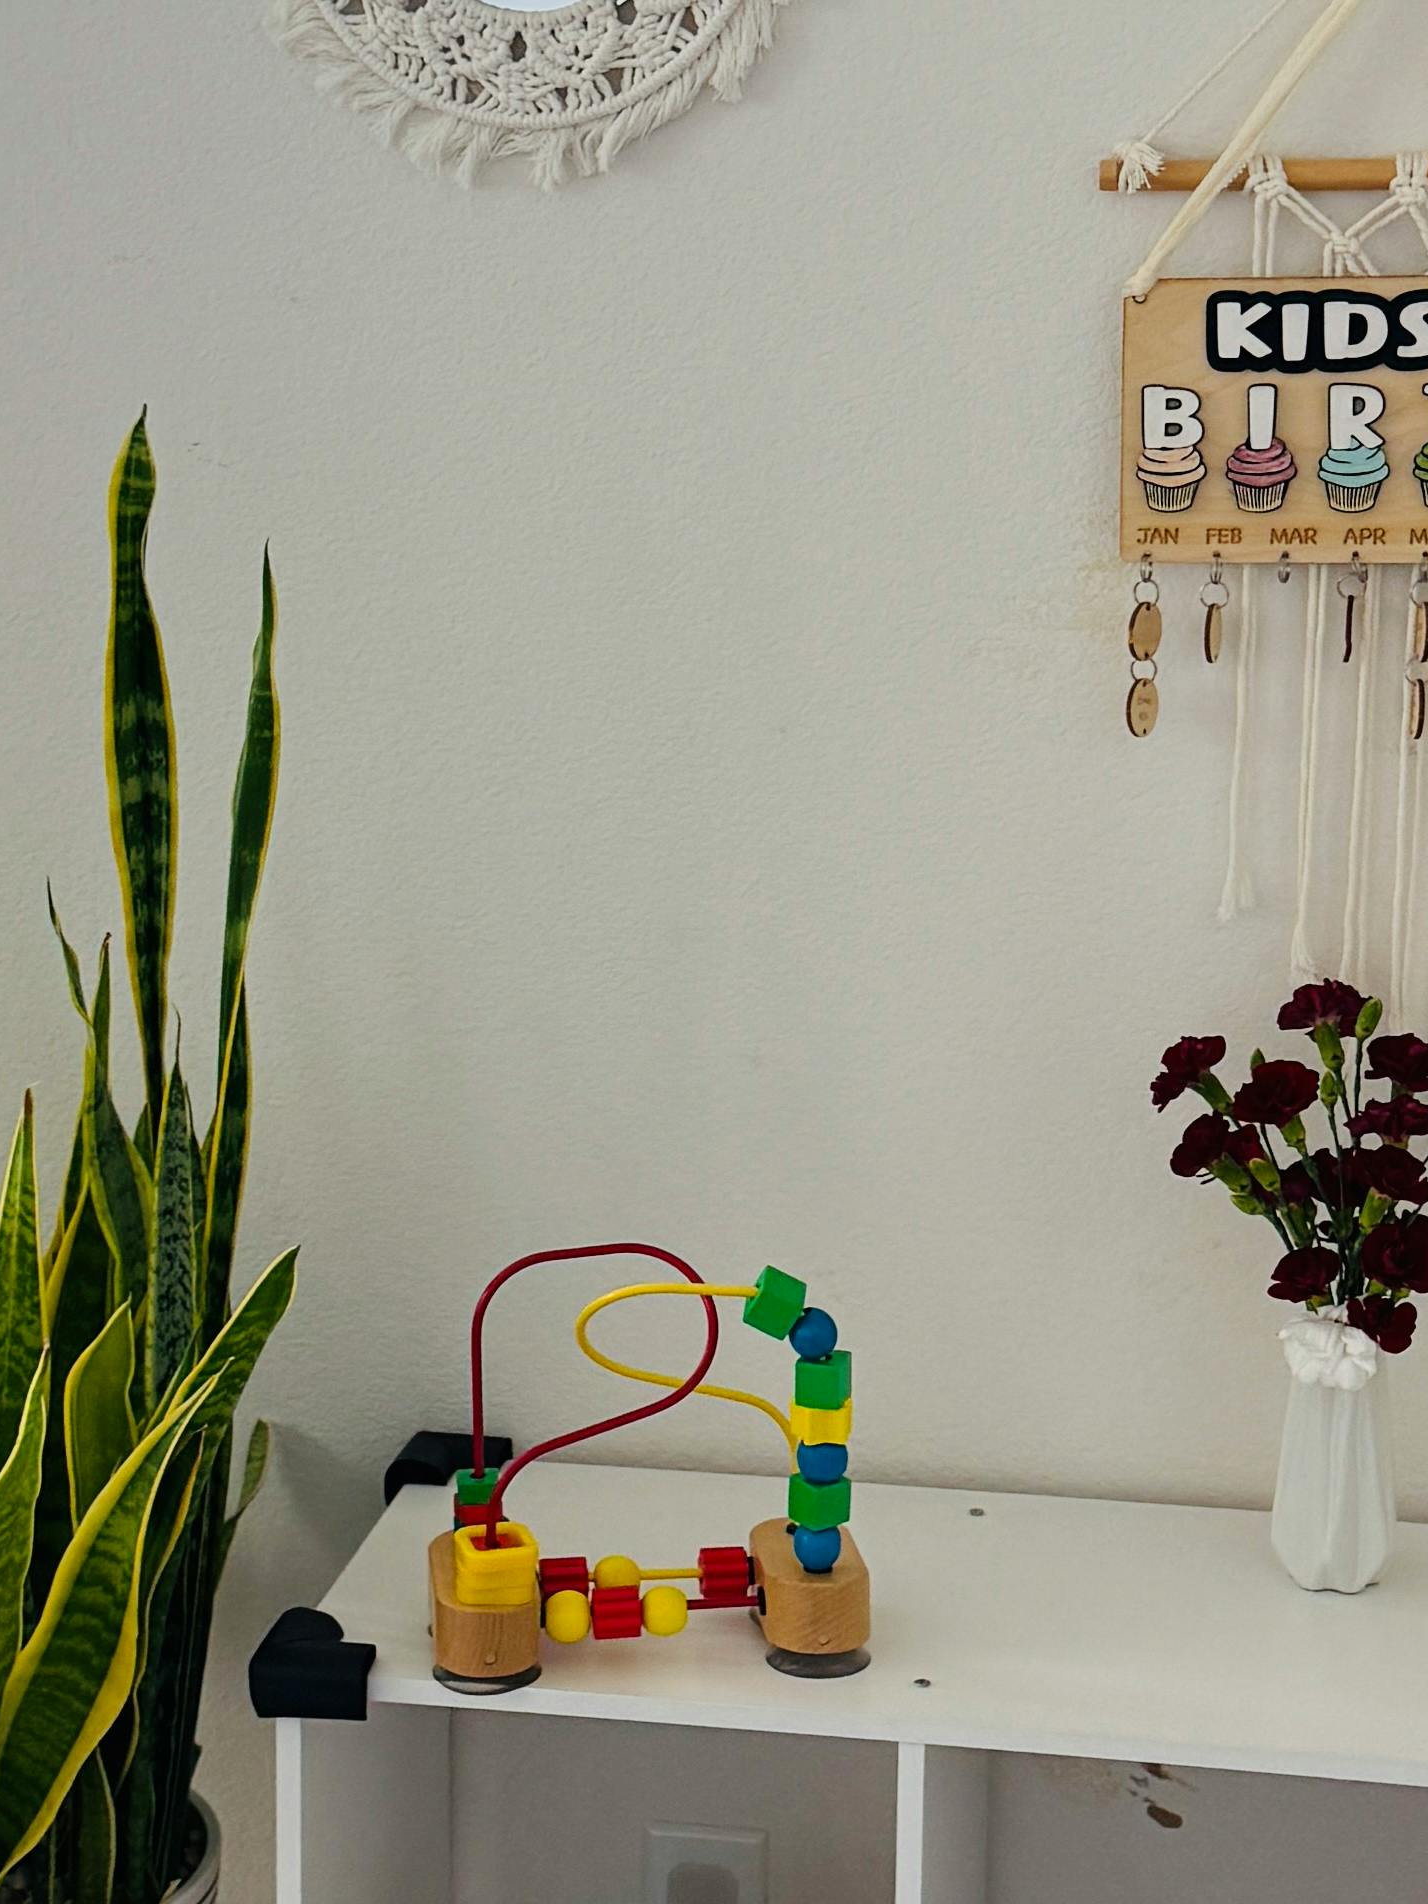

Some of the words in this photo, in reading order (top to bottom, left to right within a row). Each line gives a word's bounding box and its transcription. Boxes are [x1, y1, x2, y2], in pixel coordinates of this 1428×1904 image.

[1137, 527, 1179, 546] JAN
[1205, 527, 1242, 546] FEB
[1270, 527, 1318, 546] MAR
[1343, 527, 1387, 546] APR
